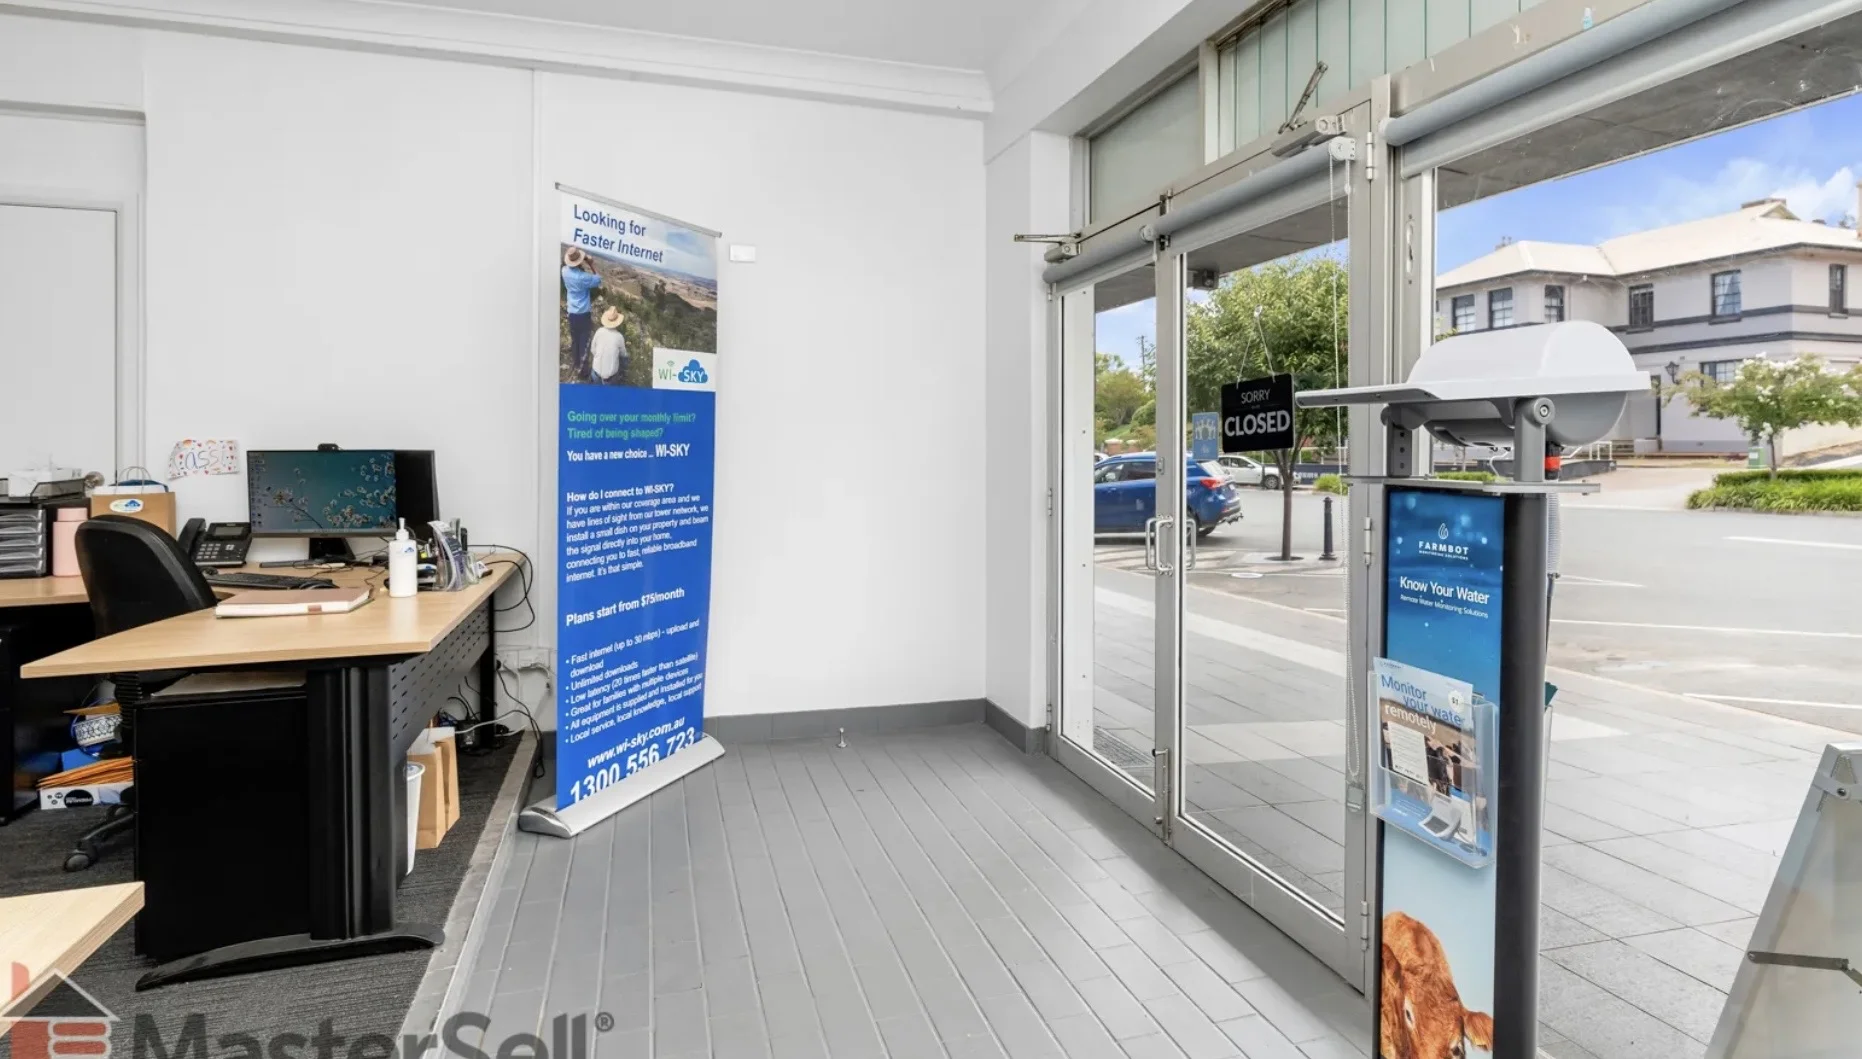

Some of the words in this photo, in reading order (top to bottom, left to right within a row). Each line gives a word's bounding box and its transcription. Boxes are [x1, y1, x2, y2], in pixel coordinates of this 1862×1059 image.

[574, 204, 626, 235] Looking
[630, 220, 647, 236] for
[573, 228, 615, 250] Faster
[618, 239, 664, 263] Internet
[1241, 388, 1271, 405] SORRY
[567, 410, 597, 424] Going
[600, 413, 617, 422] over
[619, 413, 638, 424] your
[641, 412, 671, 424] monthly
[1224, 410, 1291, 437] CLOSED
[567, 427, 593, 439] Tired
[595, 427, 604, 439] of
[605, 428, 628, 440] being
[566, 450, 584, 461] You
[585, 449, 602, 461] have
[604, 451, 609, 460] a
[609, 451, 624, 459] new
[625, 448, 648, 458] choice
[655, 443, 690, 457] WI-SKY
[566, 491, 587, 502] How
[588, 490, 599, 500] do
[604, 487, 635, 499] connect
[635, 487, 643, 495] to
[644, 483, 675, 494] WI-SKY?
[566, 505, 573, 516] If
[574, 506, 588, 517] you
[589, 505, 601, 513] are
[602, 501, 620, 511] within
[621, 501, 633, 510] our
[634, 498, 660, 508] coverage
[661, 496, 676, 504] area
[677, 494, 690, 503] and
[566, 520, 586, 529] have
[587, 517, 602, 527] lines
[604, 514, 611, 524] of
[612, 513, 627, 525] sight
[629, 511, 643, 521] from
[644, 510, 653, 519] our
[654, 508, 671, 517] tower
[672, 504, 700, 515] network,
[566, 531, 589, 543] install
[596, 527, 613, 539] small
[614, 525, 628, 535] dish
[629, 525, 638, 533] on
[639, 523, 652, 533] your
[652, 519, 678, 531] property
[679, 517, 691, 526] and
[692, 515, 709, 524] beam
[565, 555, 605, 570] connecting
[606, 552, 619, 564] you
[618, 550, 626, 559] to
[627, 547, 641, 558] fast,
[642, 543, 663, 554] reliable
[663, 538, 698, 551] broadband
[566, 546, 579, 556] the
[580, 541, 601, 556] signal
[602, 538, 625, 550] directly
[626, 536, 638, 546] into
[639, 535, 652, 545] your
[652, 532, 672, 541] home.
[1418, 540, 1469, 555] FARMBOT
[565, 569, 595, 583] internet.
[597, 566, 607, 576] It's
[607, 563, 620, 574] that
[621, 559, 643, 571] simple.
[1400, 576, 1428, 592] Know
[1429, 580, 1454, 598] Your
[1456, 586, 1490, 605] Water
[566, 611, 595, 627] Plans
[596, 603, 617, 619] start
[618, 600, 639, 612] from
[641, 587, 685, 608] $75/month
[1400, 594, 1418, 604] Remote
[1418, 598, 1433, 607] Water
[1434, 600, 1462, 615] Monitoring
[1463, 607, 1489, 619] Solutions
[571, 652, 588, 665] Fast
[588, 643, 613, 660] internet
[613, 641, 626, 652] (up
[626, 638, 633, 648] to
[634, 634, 643, 645] 30
[642, 628, 660, 642] mbps)
[665, 621, 689, 635] upload
[688, 618, 700, 629] and
[570, 659, 604, 678] download
[571, 671, 604, 690] Unlimited
[604, 660, 639, 679] downloads
[1381, 674, 1427, 699] Monitor
[570, 718, 580, 730] All
[581, 704, 615, 726] equipment
[615, 702, 622, 711] is
[623, 692, 648, 708] supplied
[648, 686, 660, 698] and
[660, 678, 686, 693] installed
[686, 675, 695, 685] for
[694, 672, 703, 683] you
[570, 727, 590, 744] Local
[591, 718, 616, 735] service,
[616, 709, 633, 723] local
[633, 697, 667, 717] knowledge,
[667, 690, 683, 702] local
[683, 682, 702, 697] support
[1402, 695, 1428, 712] your
[1385, 703, 1437, 735] remotely
[587, 716, 685, 769] www.wi-sky.com.au
[570, 762, 620, 803] 1300
[625, 742, 660, 777] 556
[666, 726, 695, 757] 723
